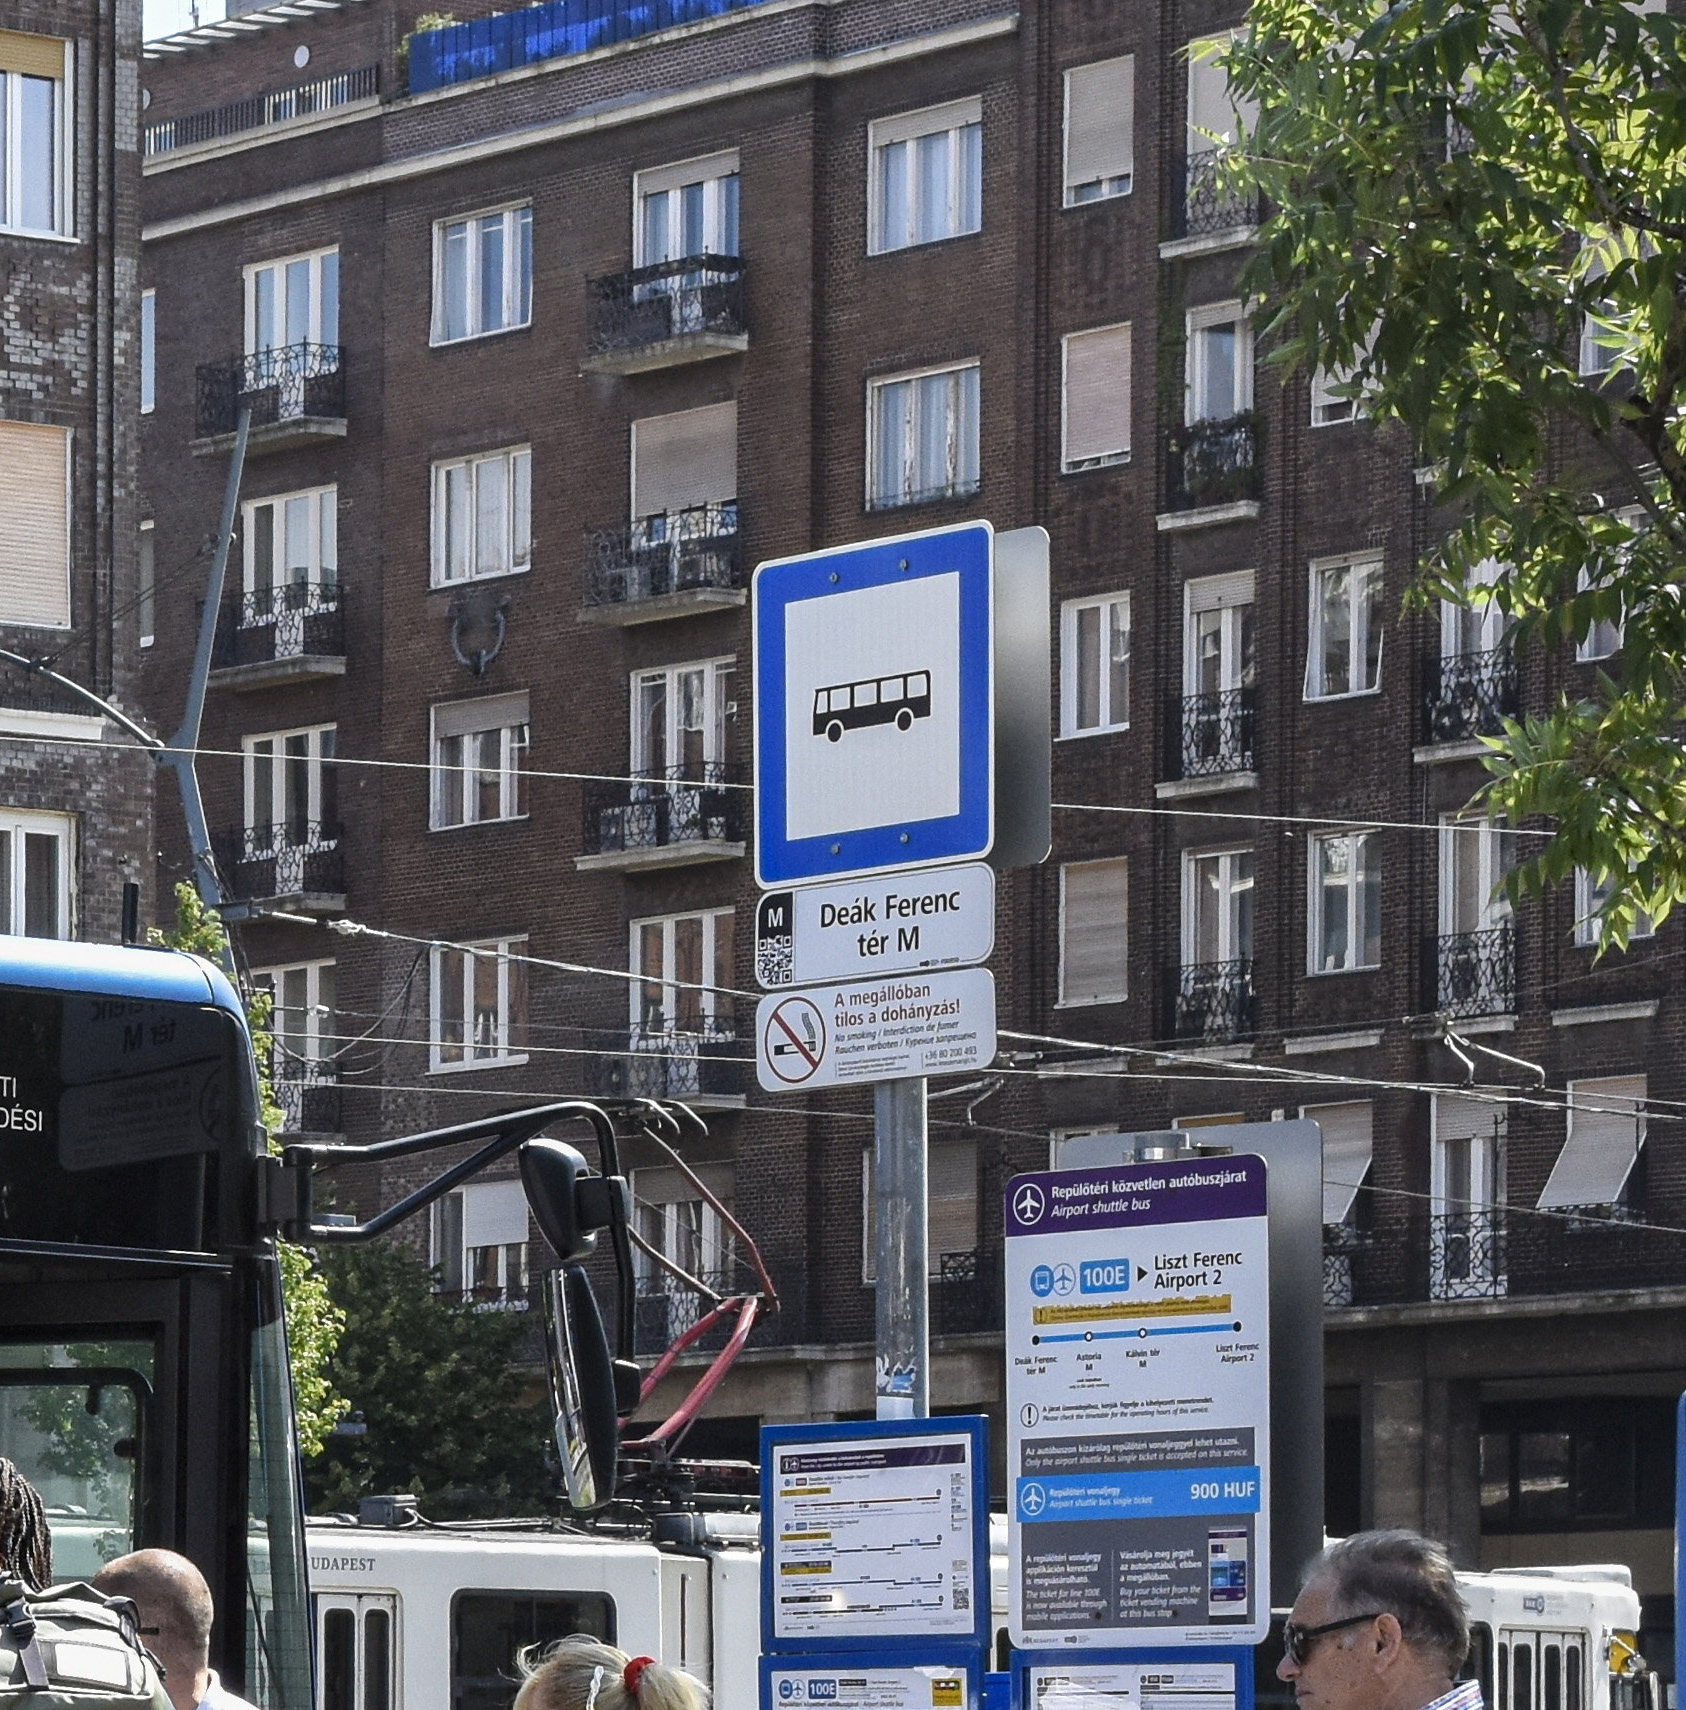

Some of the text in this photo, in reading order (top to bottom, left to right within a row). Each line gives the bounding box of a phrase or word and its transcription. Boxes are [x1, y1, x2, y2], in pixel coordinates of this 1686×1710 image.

[768, 907, 783, 928] M
[820, 890, 961, 928] Deák Ferenc
[857, 925, 920, 957] tér M
[834, 983, 931, 1008] A megállóban
[834, 998, 961, 1028] tilos a dohányzás!
[1051, 1170, 1247, 1200] Repülőtéri közvetlen autóbuszjárat
[1051, 1197, 1151, 1219] Airport shuttle bus
[1083, 1249, 1243, 1287] 100E Liszt Ferenc
[1154, 1269, 1222, 1292] Airport 2
[1076, 1352, 1102, 1362] Astoria
[1215, 1342, 1259, 1353] Liszt Ferenc
[1220, 1355, 1247, 1364] Airport
[1190, 1480, 1256, 1500] 900 HUF
[308, 1556, 377, 1572] UDAPEST
[809, 1682, 836, 1696] 100E
